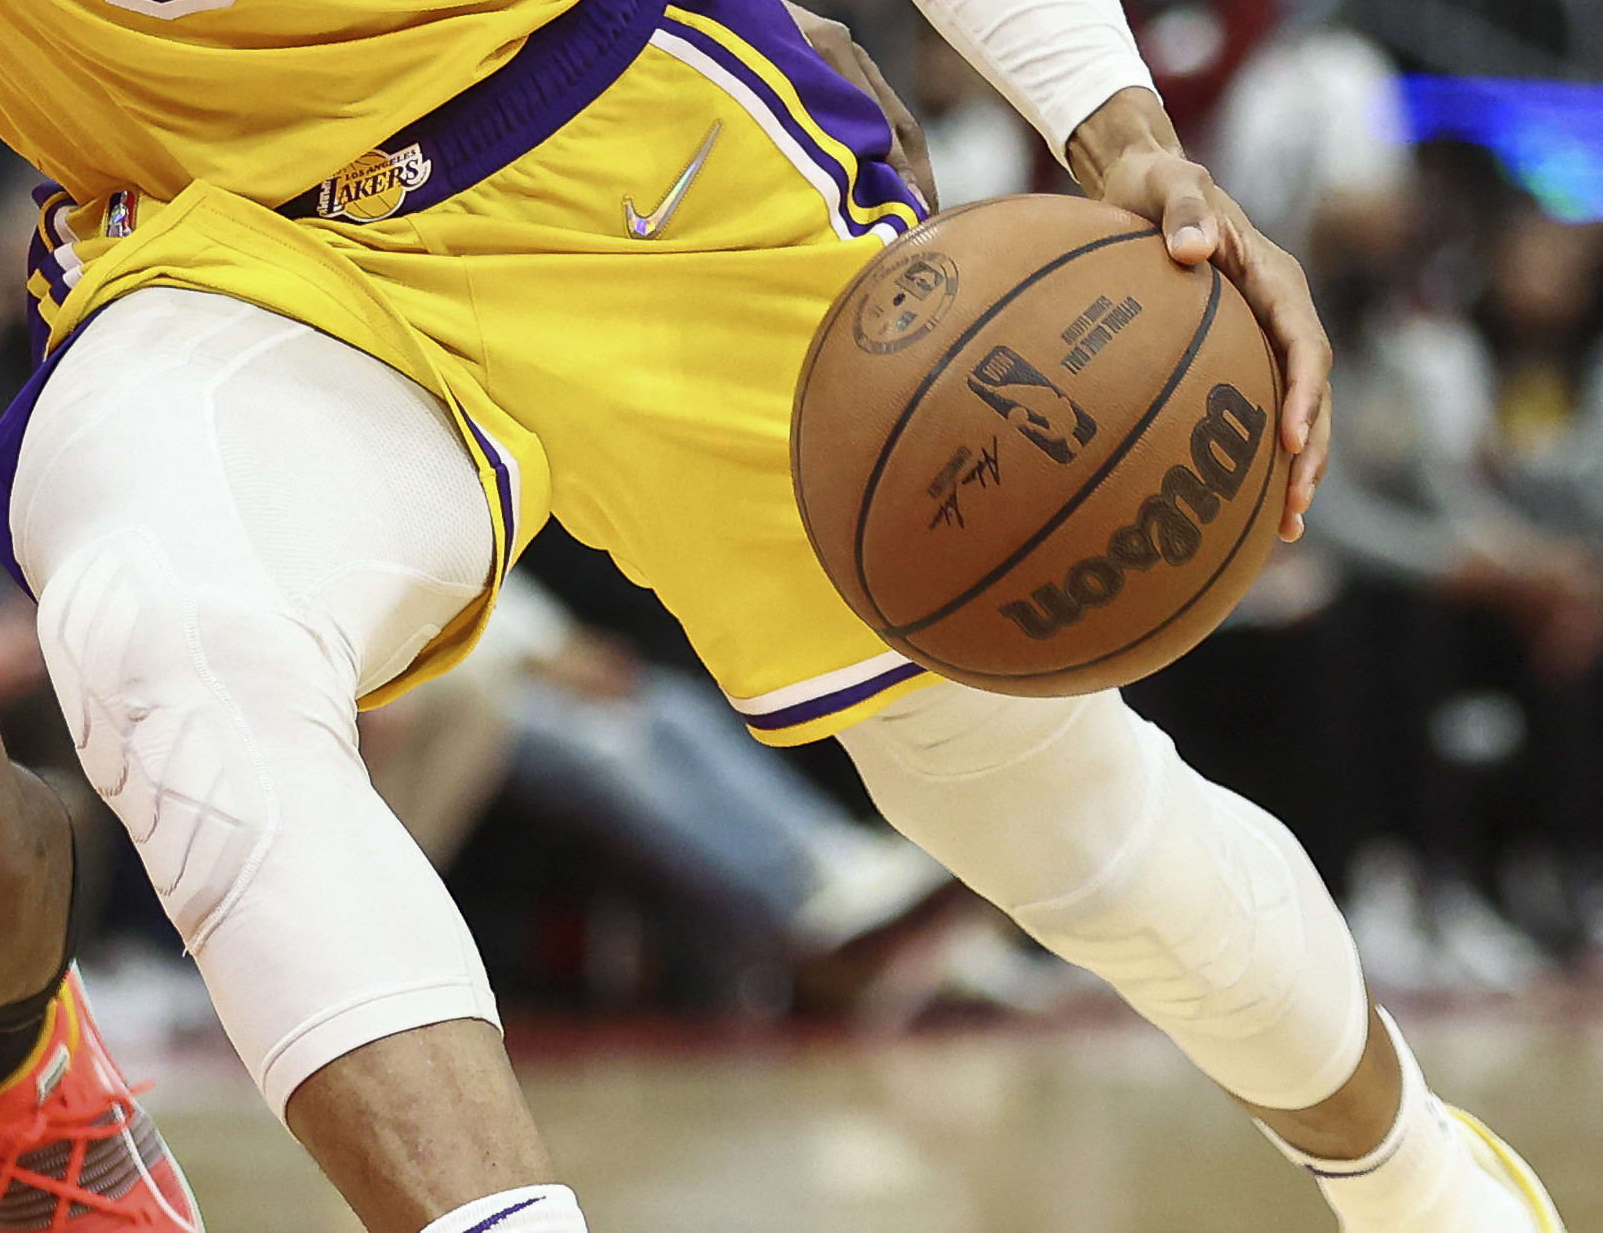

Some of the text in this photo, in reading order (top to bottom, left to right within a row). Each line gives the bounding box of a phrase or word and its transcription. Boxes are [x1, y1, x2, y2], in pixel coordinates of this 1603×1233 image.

[317, 158, 426, 214] LAKERS
[345, 168, 365, 181] LOS
[996, 382, 1268, 641] Wilson
